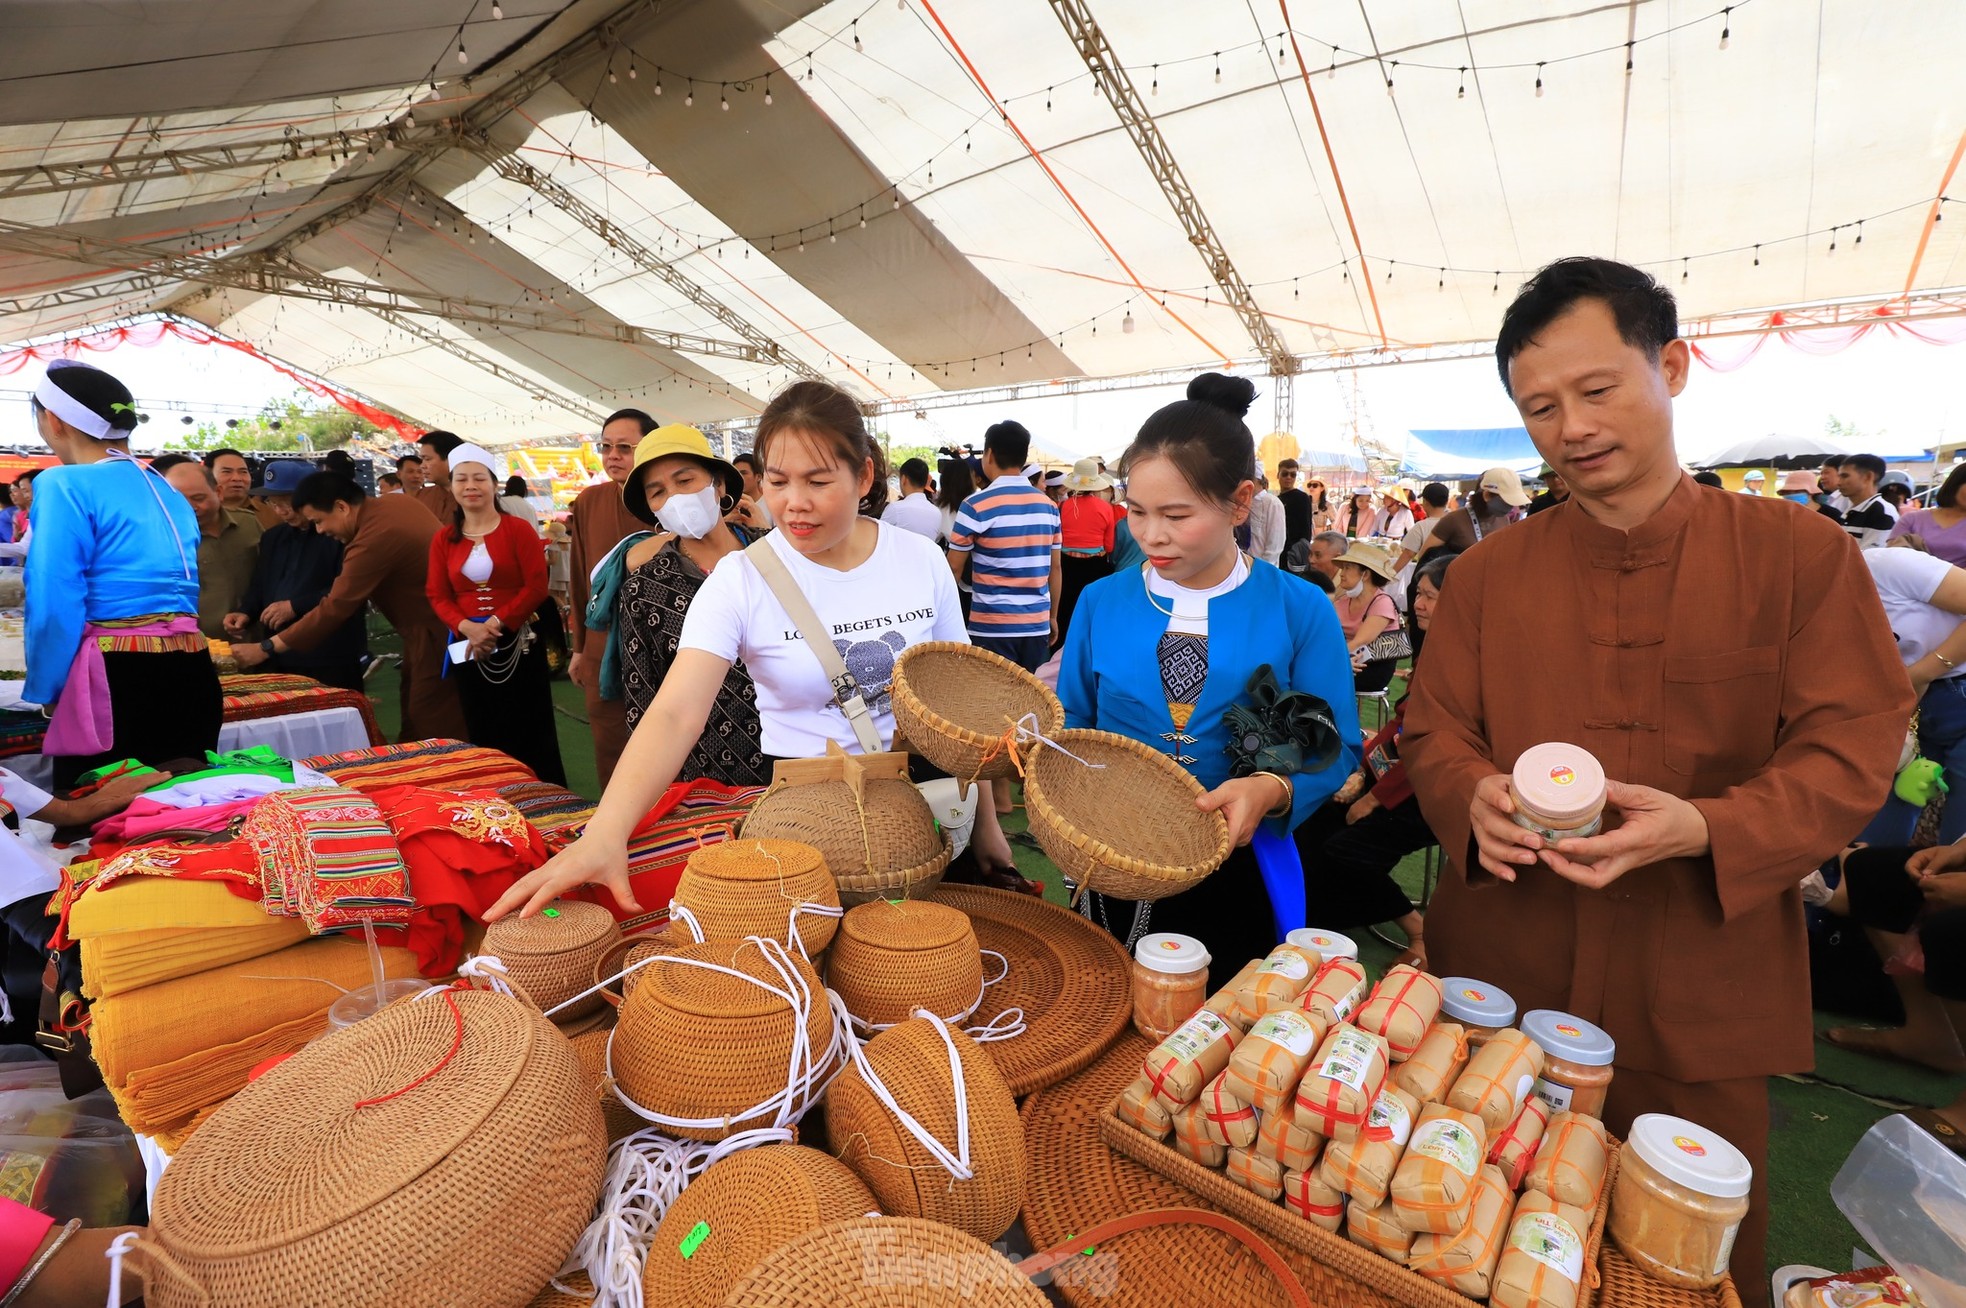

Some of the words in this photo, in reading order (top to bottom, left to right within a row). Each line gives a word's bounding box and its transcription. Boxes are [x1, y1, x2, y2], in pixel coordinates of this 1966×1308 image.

[784, 630, 804, 641] LO
[833, 616, 892, 635] BEGETS
[897, 607, 934, 624] LOVE
